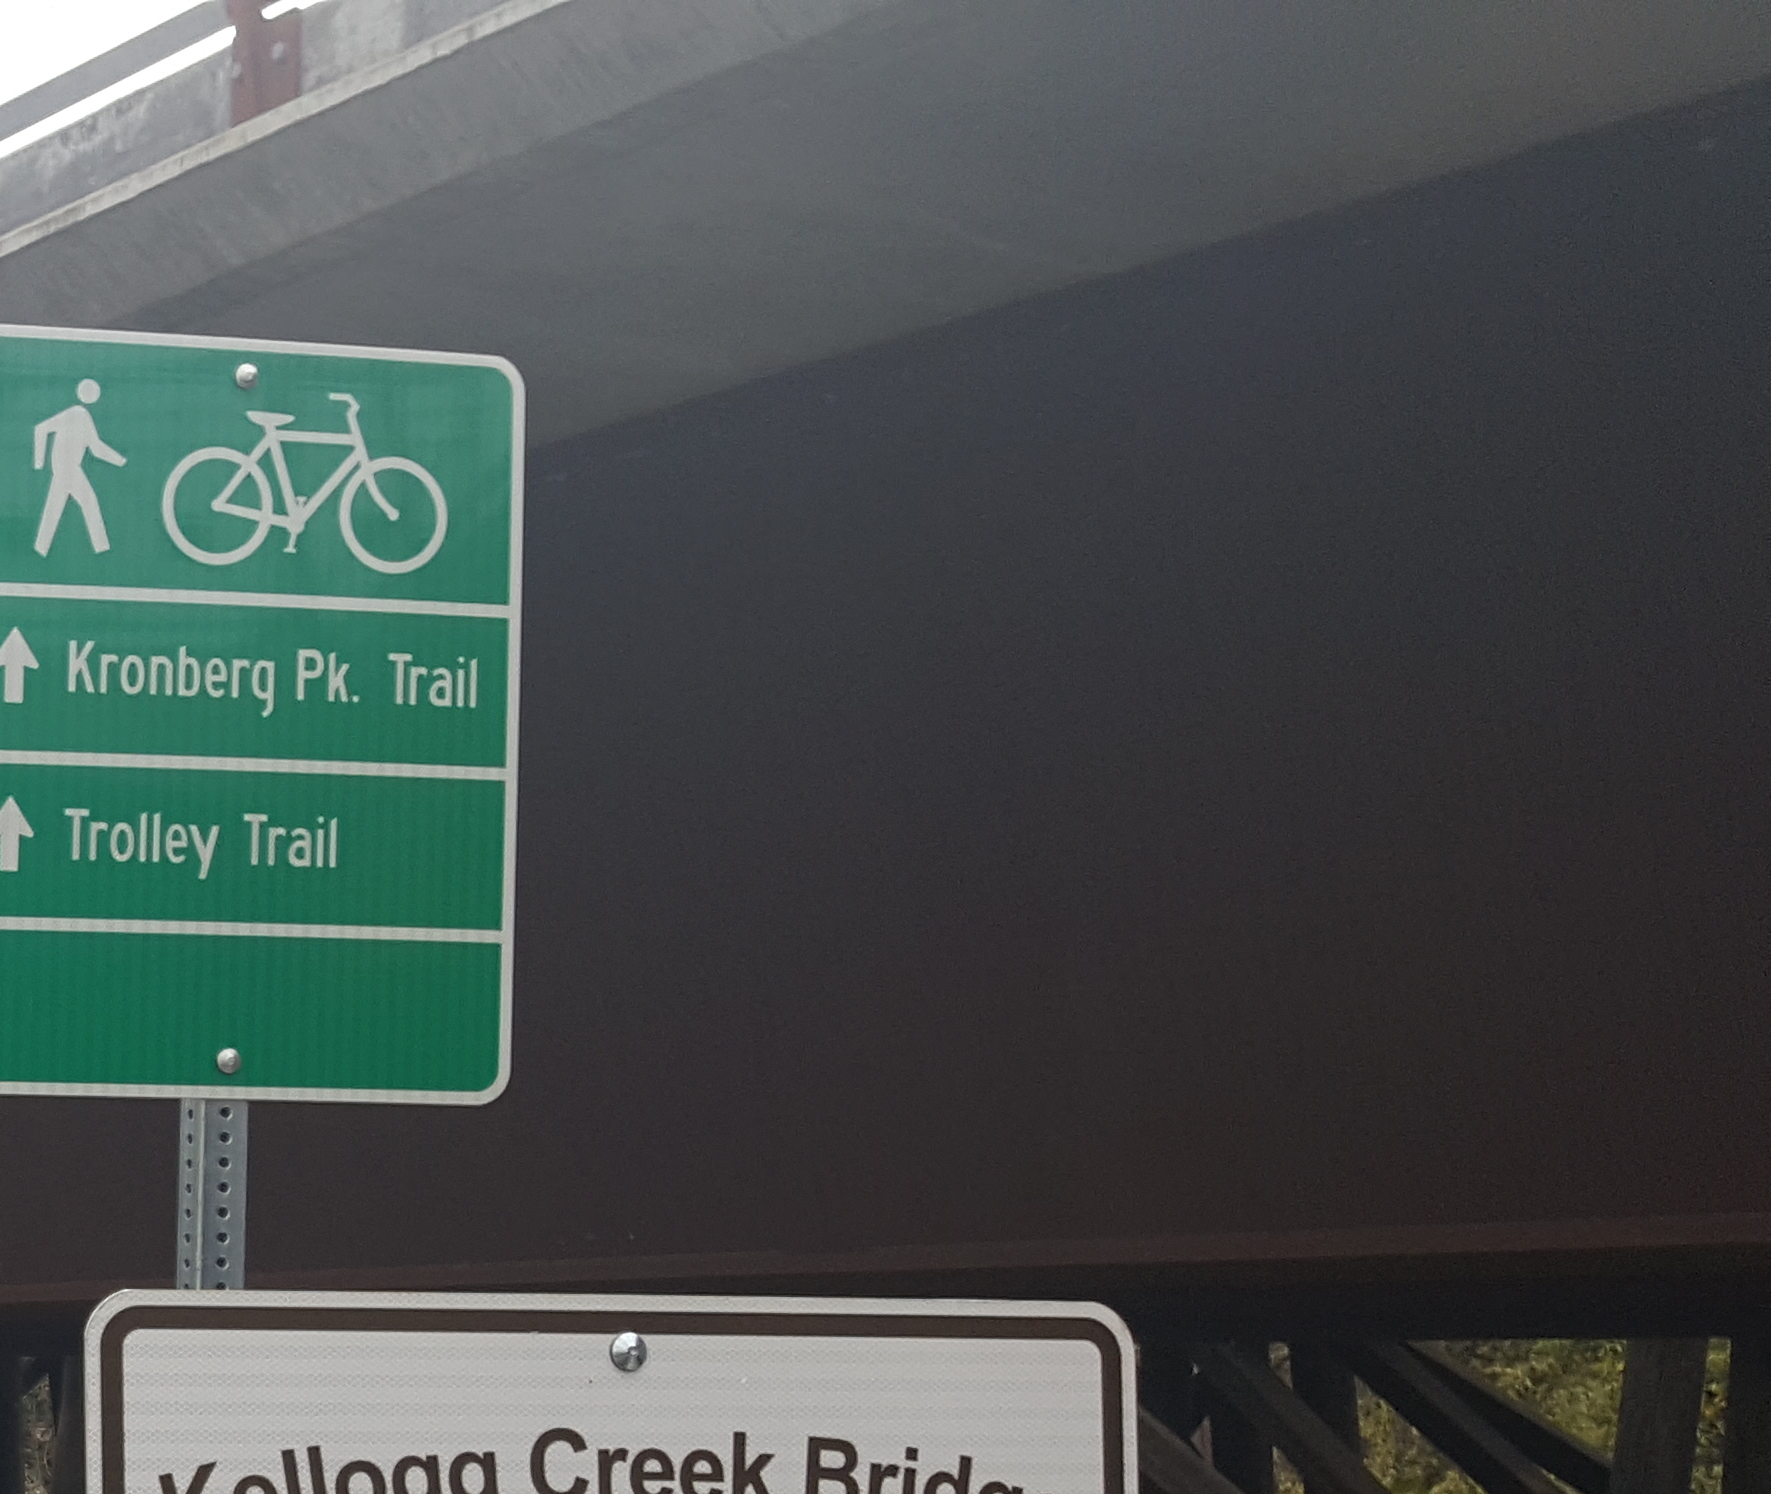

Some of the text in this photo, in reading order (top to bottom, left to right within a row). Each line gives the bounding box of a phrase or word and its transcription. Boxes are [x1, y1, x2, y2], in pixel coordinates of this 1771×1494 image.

[68, 640, 477, 717] Kronberg Pk. Trail
[65, 808, 337, 879] Trolley Trail
